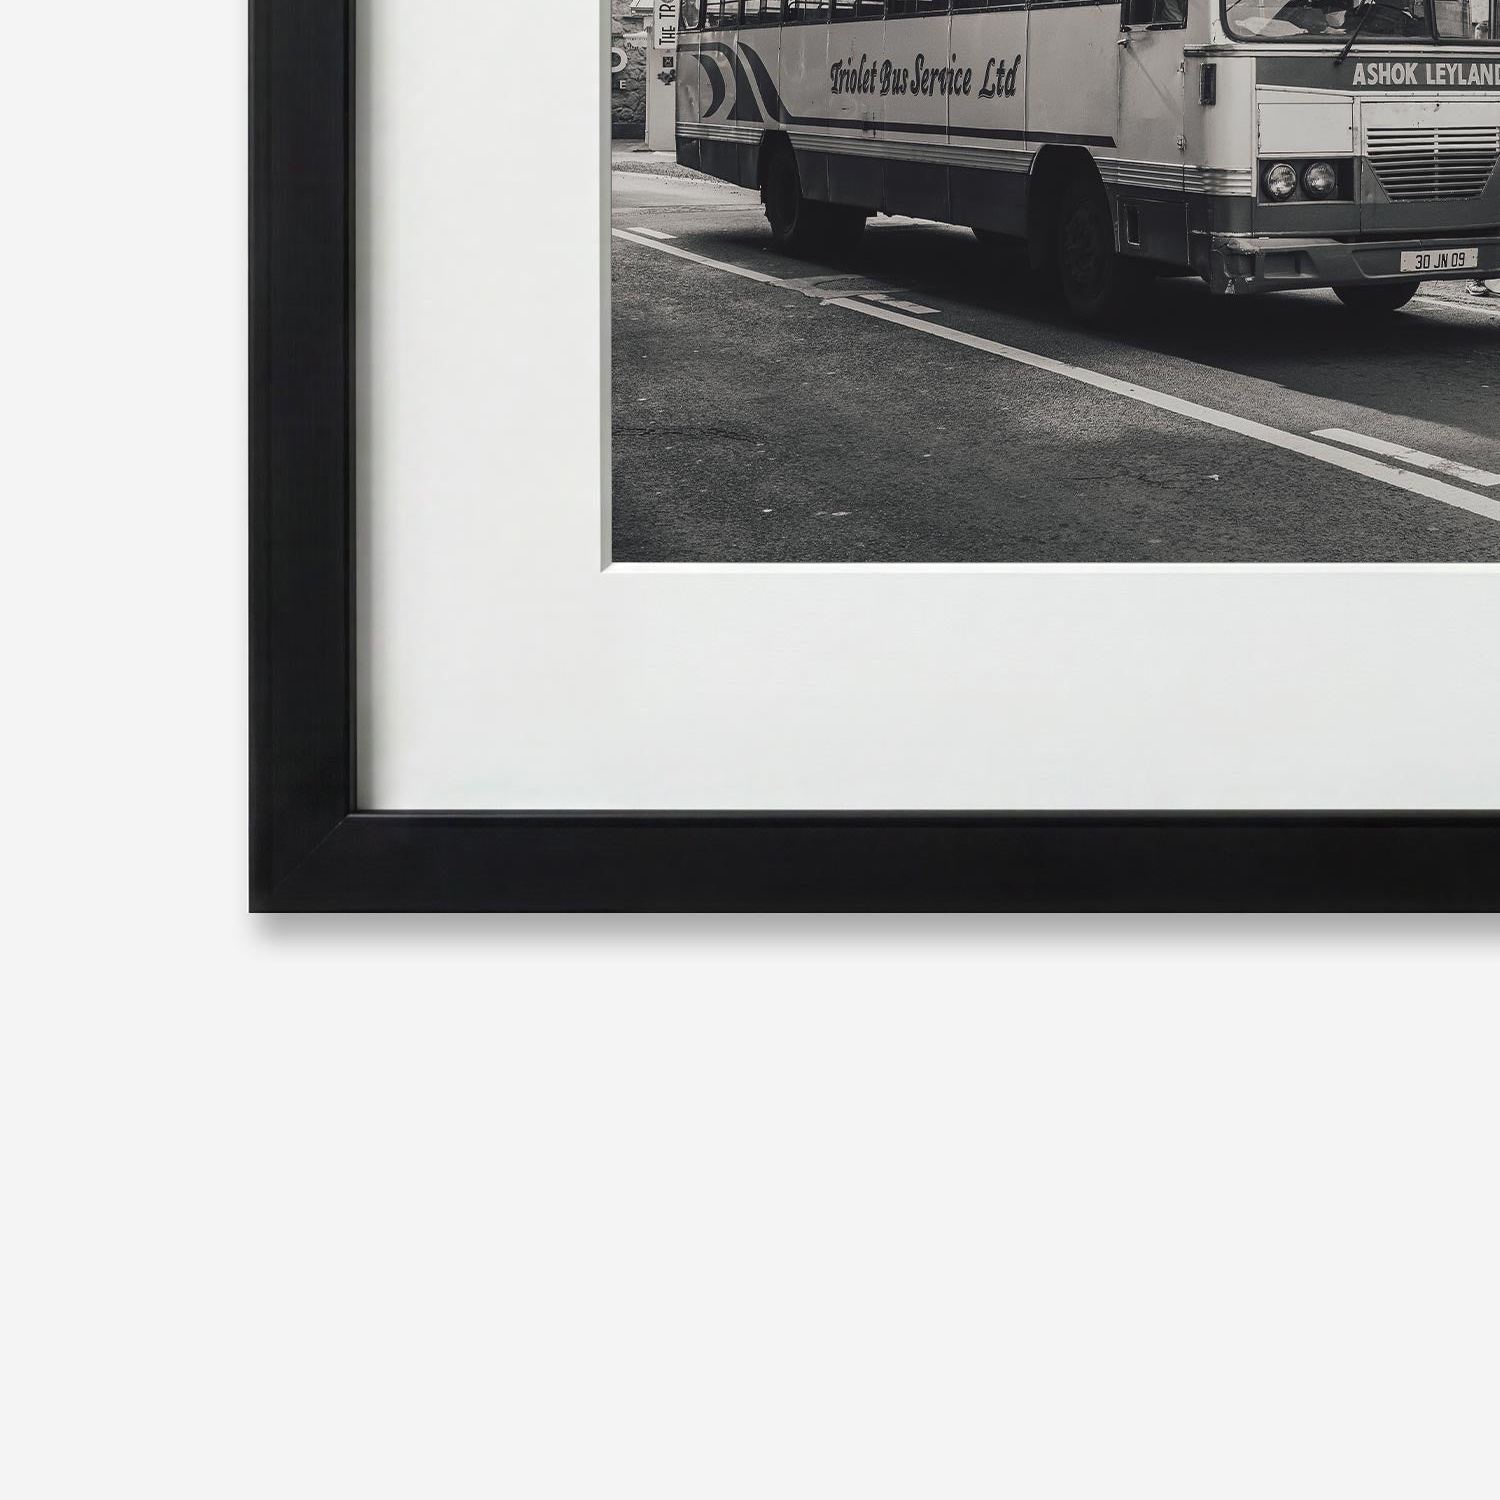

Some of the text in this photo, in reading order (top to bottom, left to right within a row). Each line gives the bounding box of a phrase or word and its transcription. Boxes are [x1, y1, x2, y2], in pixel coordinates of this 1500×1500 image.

[830, 53, 1022, 100] Triolet Bus Service Ltd
[1352, 62, 1419, 86] ASHOK
[1415, 252, 1466, 270] 30 JN 09
